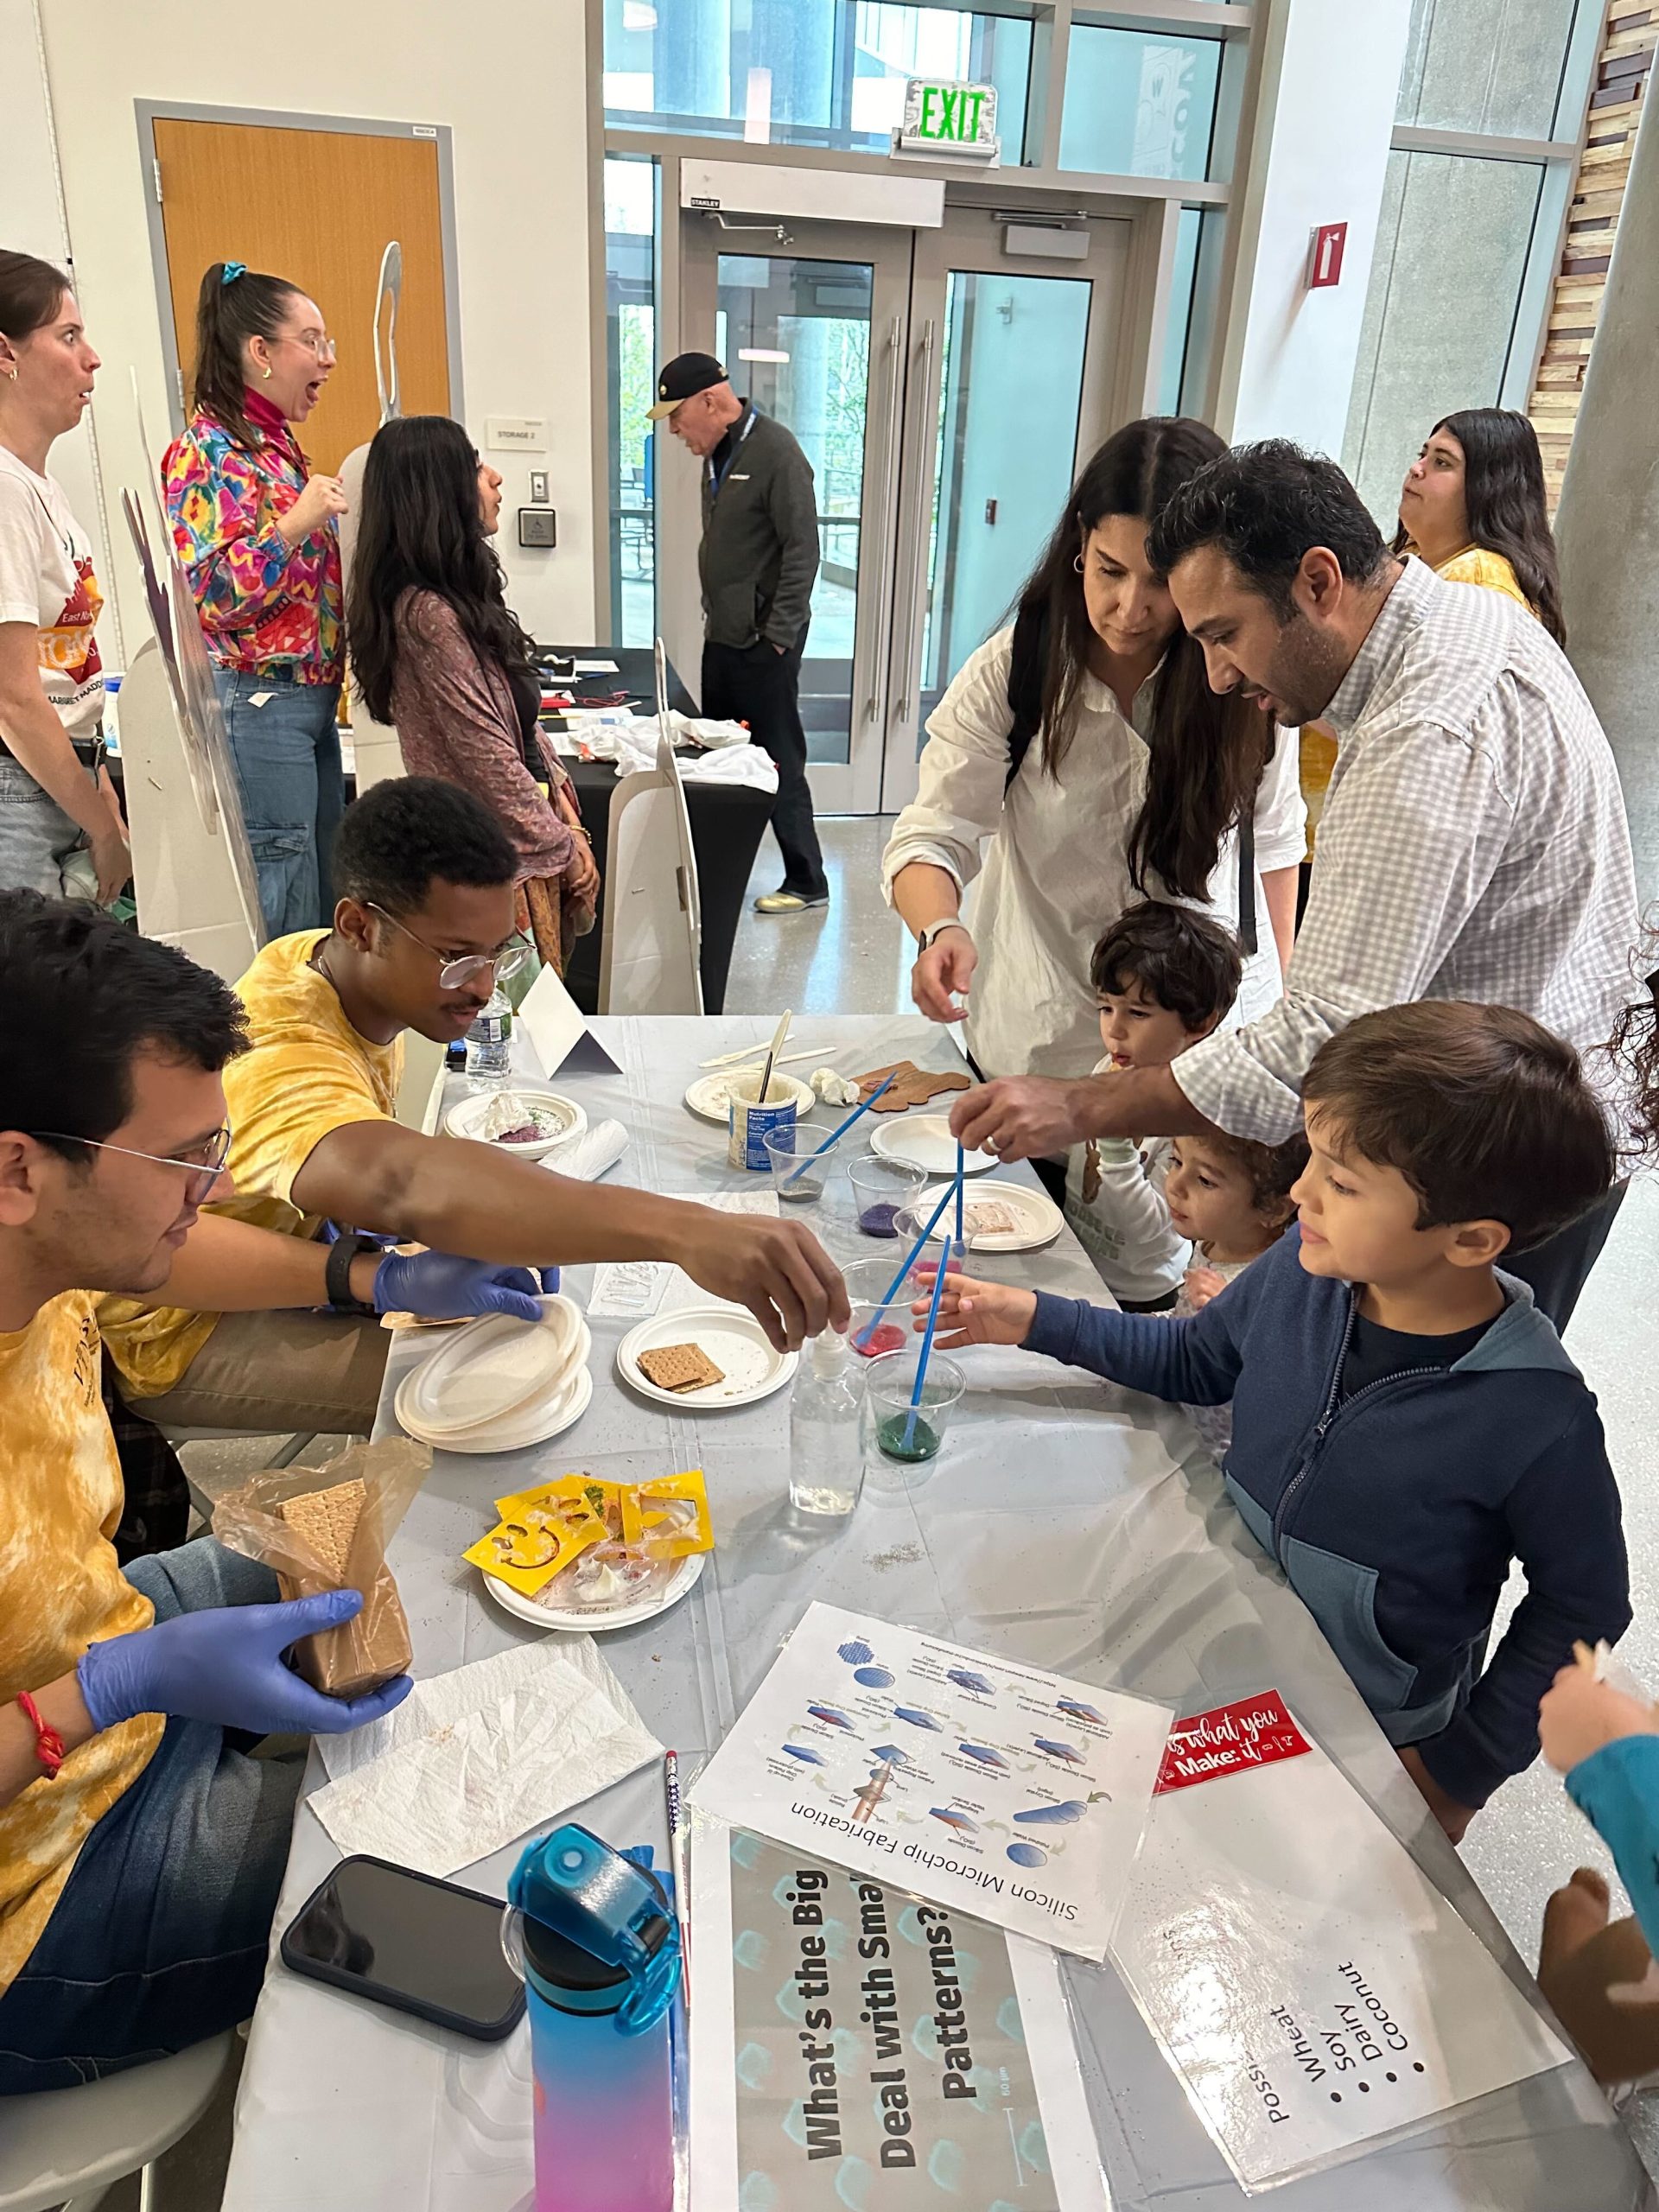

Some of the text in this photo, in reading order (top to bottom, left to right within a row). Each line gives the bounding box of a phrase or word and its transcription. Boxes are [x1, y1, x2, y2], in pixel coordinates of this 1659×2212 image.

[920, 86, 986, 143] EXIT
[498, 430, 528, 439] STORAGE
[62, 613, 80, 623] East
[1174, 1737, 1262, 1777] Make: it
[1186, 1712, 1240, 1748] what
[1239, 1709, 1278, 1742] you
[787, 1800, 1078, 1923] Silicon Microchip Fabrication
[786, 1870, 842, 2160] What's the Big
[849, 1872, 917, 2168] Deal with Sma
[917, 1905, 977, 2099] Patterns?
[1334, 2004, 1383, 2062] Dairy
[1338, 1961, 1408, 2051] Coconut
[1270, 2005, 1326, 2083] Wheat
[1320, 2031, 1356, 2071] Soy
[1245, 2053, 1290, 2123] Possi
